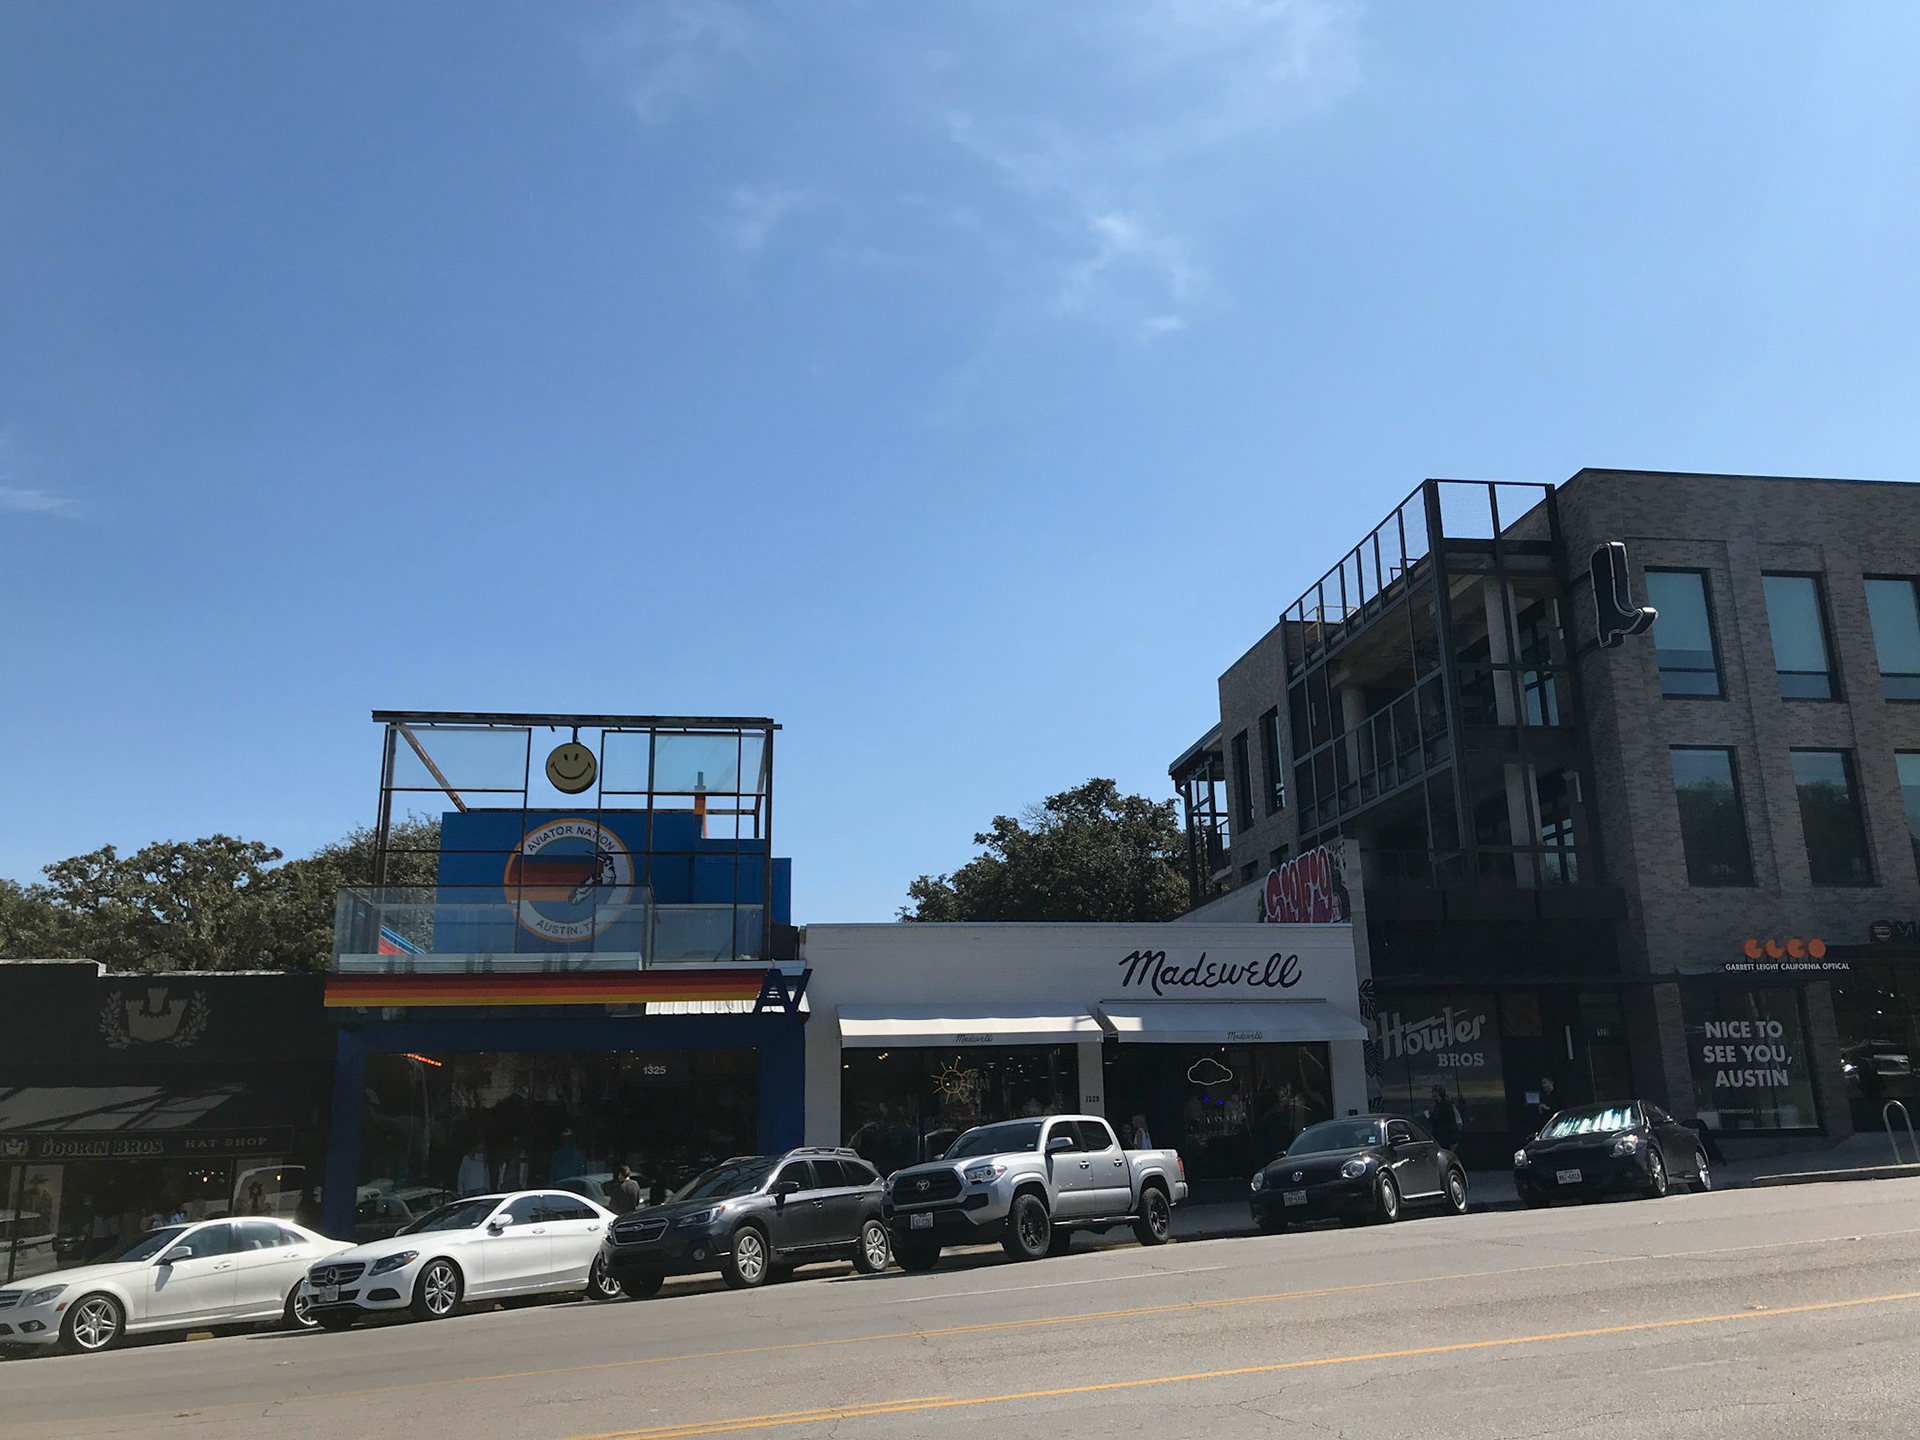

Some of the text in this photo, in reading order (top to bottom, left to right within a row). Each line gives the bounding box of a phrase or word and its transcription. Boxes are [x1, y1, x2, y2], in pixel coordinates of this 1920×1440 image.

[527, 825, 615, 852] AVIATOR NATION
[1119, 950, 1301, 996] Madewell
[1725, 962, 1850, 971] GARRETT LEIGHT CALIFORNIA OPTICAL
[1377, 1006, 1486, 1060] Howler
[1704, 1021, 1783, 1038] NICE TO
[1437, 1052, 1485, 1067] BROS
[1703, 1045, 1792, 1065] SEE YOU,
[642, 1065, 667, 1075] 1325
[1715, 1069, 1789, 1088] AUSTIN
[185, 1136, 268, 1148] HAT SHOP
